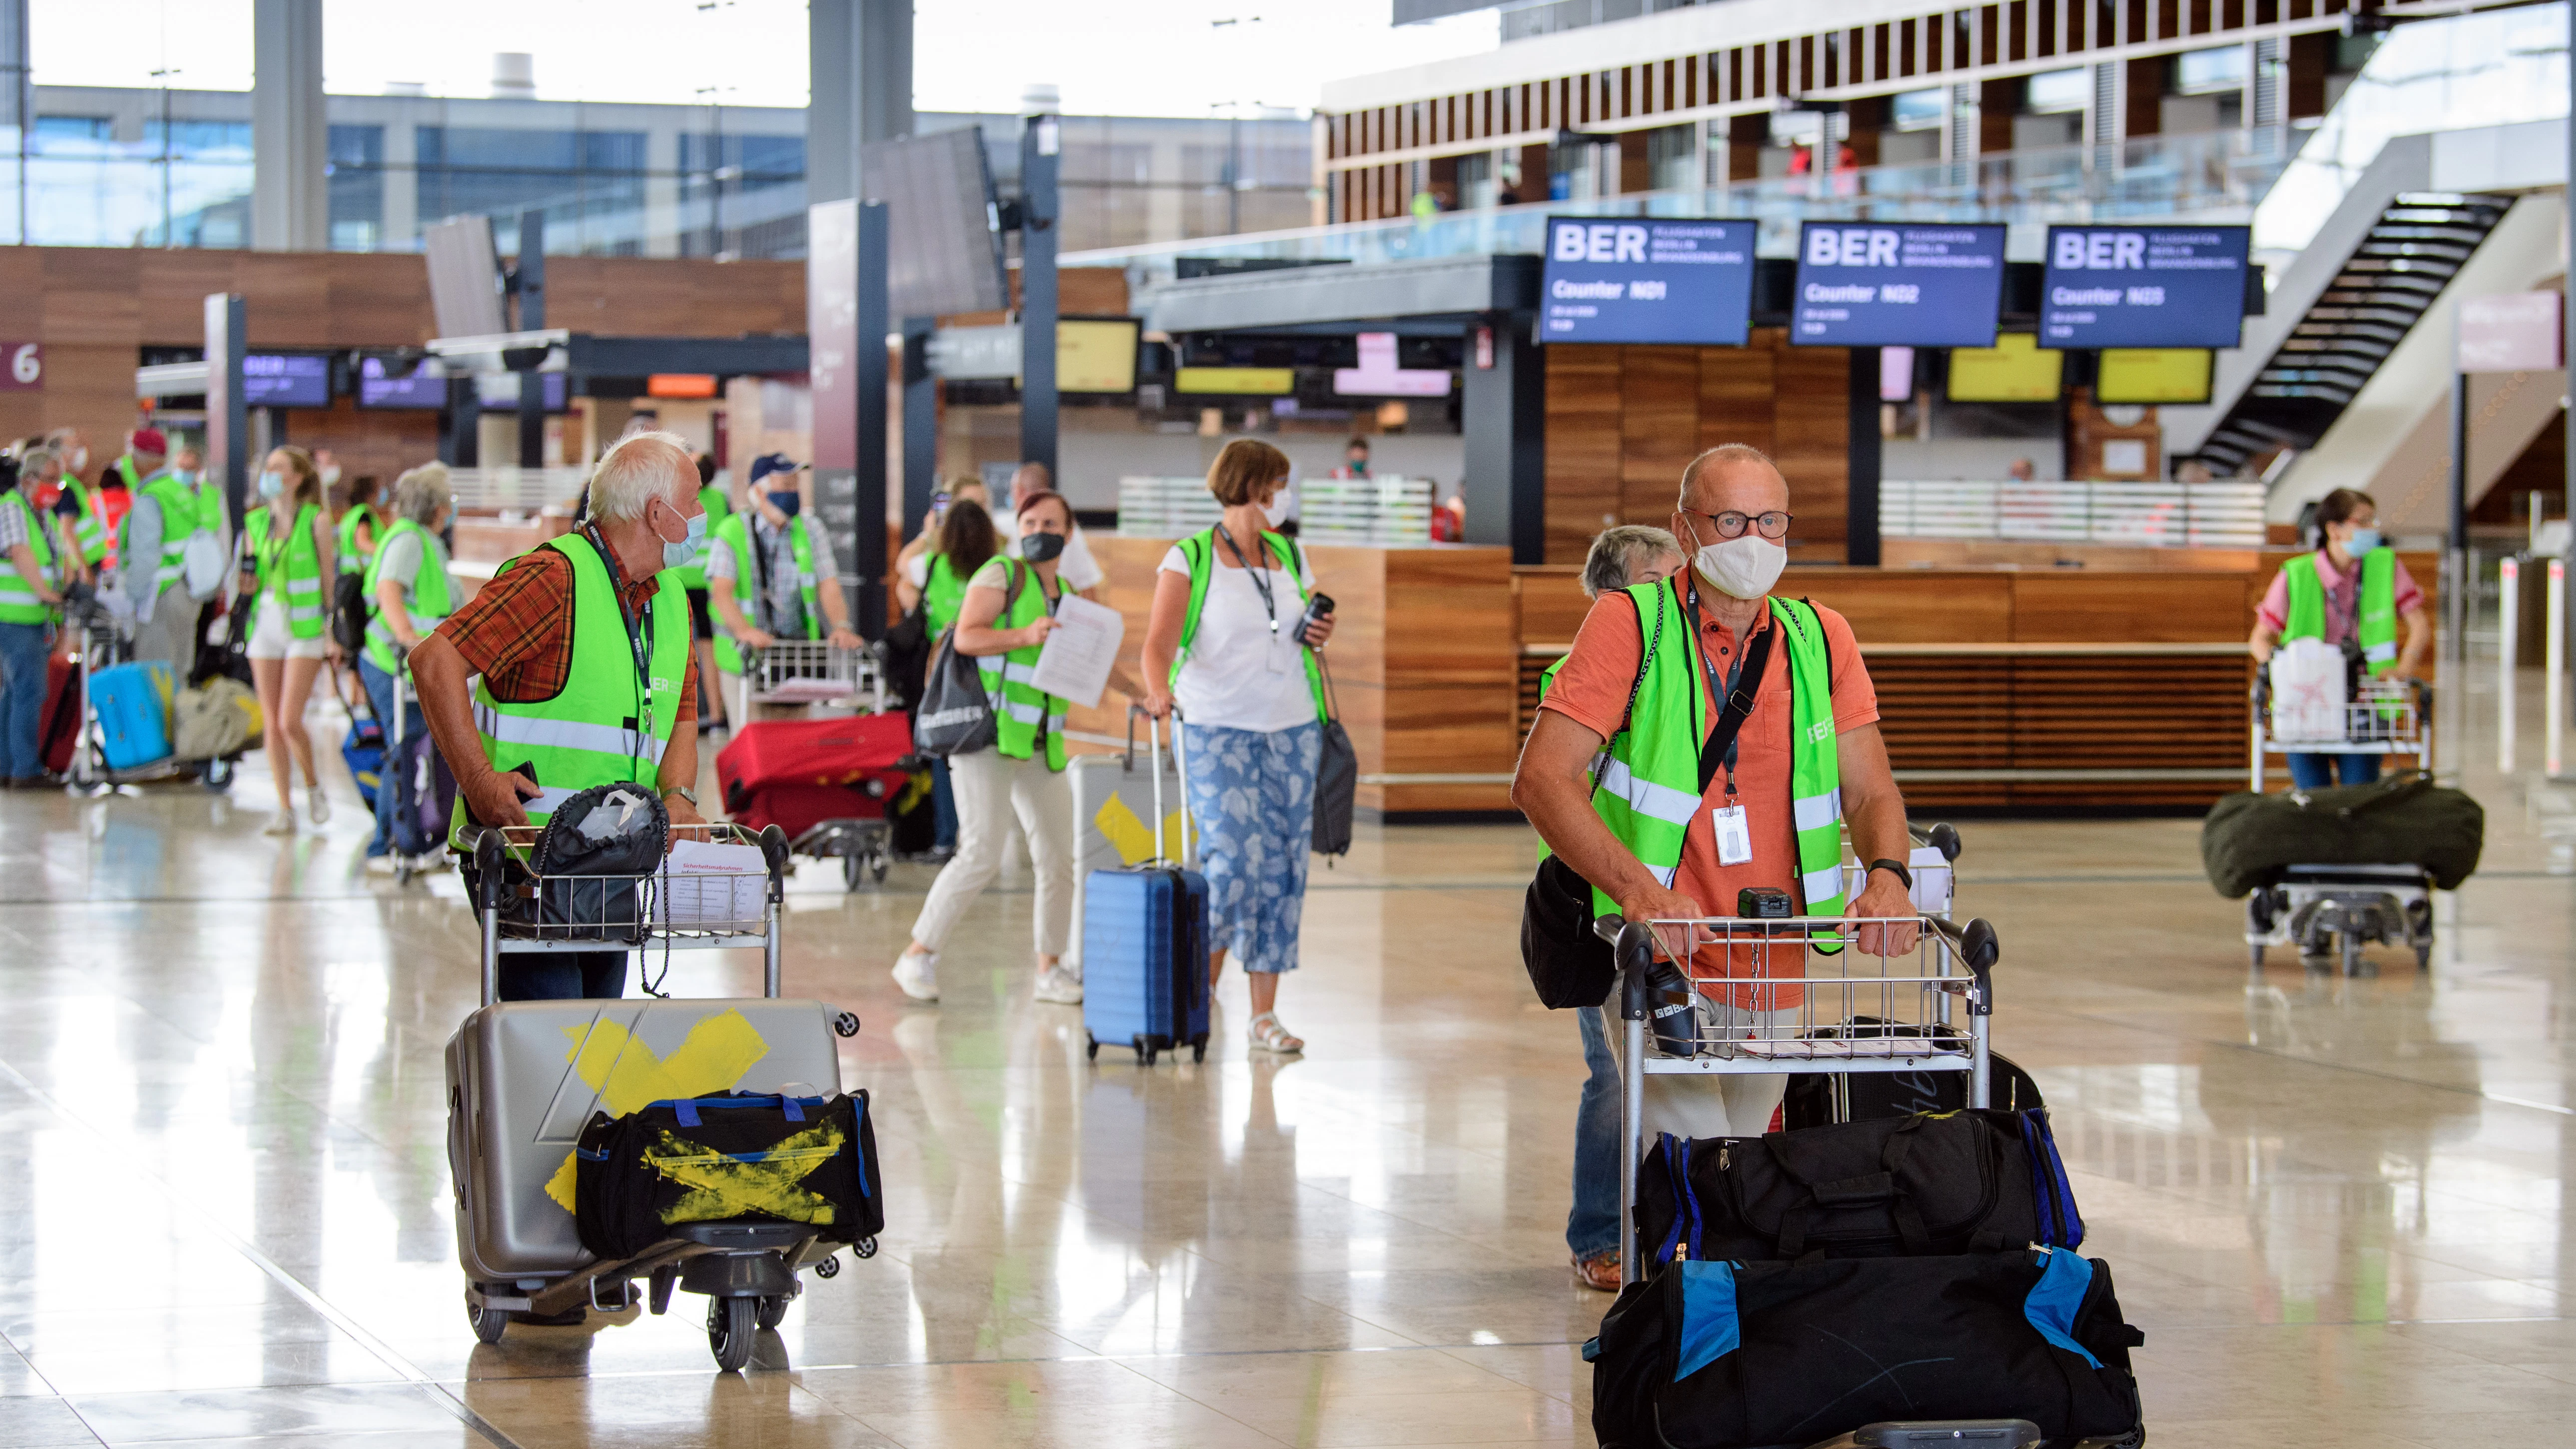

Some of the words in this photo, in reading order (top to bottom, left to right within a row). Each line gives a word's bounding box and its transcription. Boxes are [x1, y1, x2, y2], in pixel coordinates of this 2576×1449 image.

[1554, 224, 1649, 263] BER
[1807, 228, 1900, 267] BER
[2053, 232, 2146, 270] BER
[1552, 279, 1625, 300] Counter
[1804, 282, 1877, 303] Counter
[2051, 285, 2123, 306] Counter
[11, 343, 40, 384] 6
